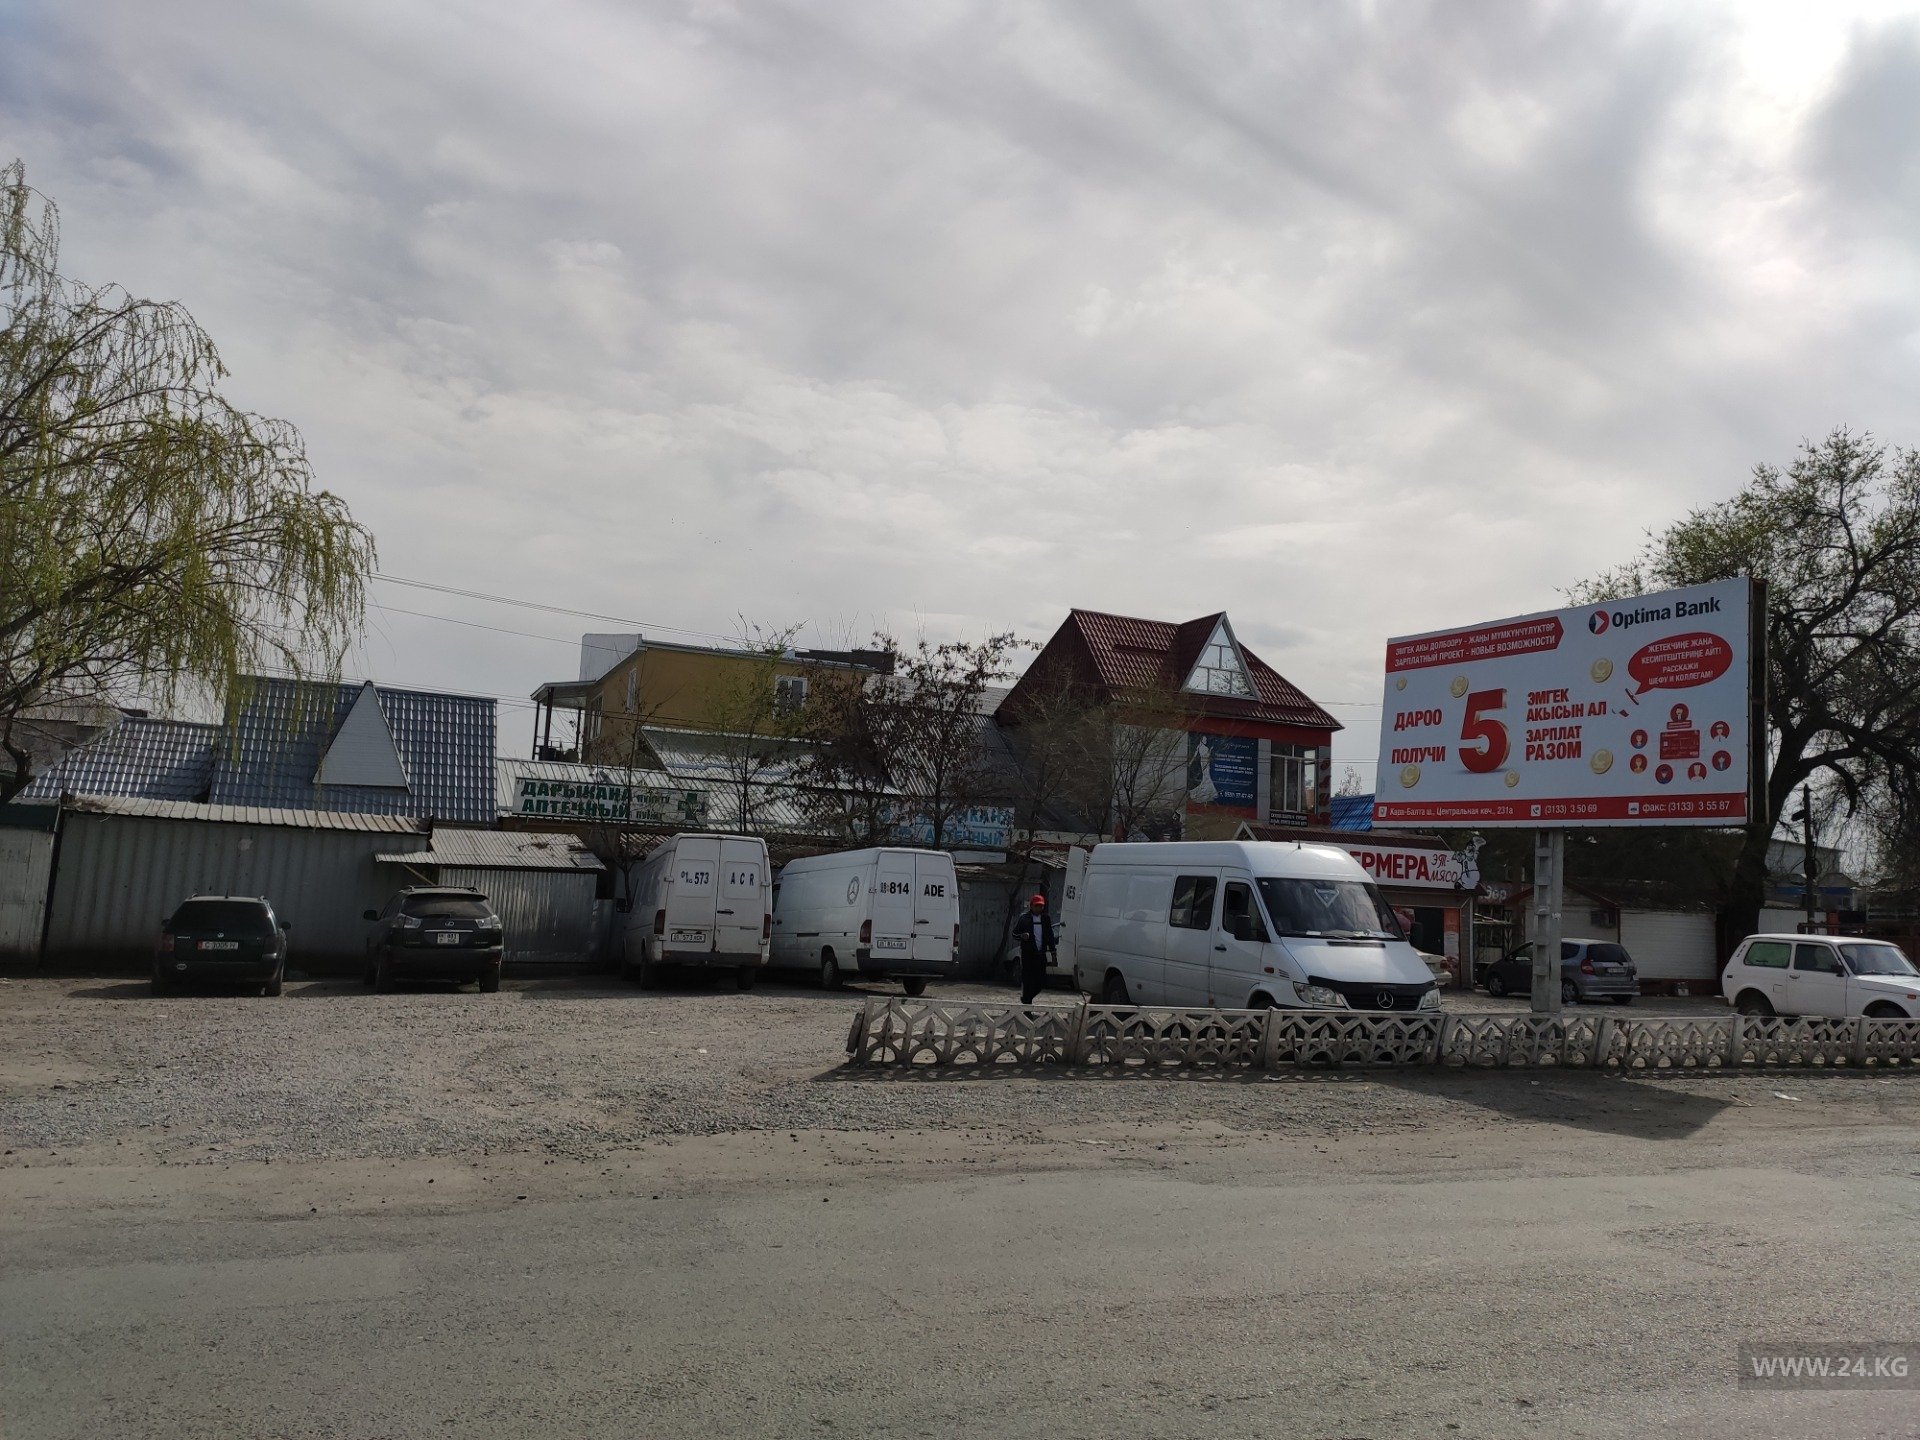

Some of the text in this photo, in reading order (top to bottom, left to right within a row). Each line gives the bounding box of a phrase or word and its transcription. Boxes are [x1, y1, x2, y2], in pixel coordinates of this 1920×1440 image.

[1612, 597, 1721, 629] Optima Bank
[1690, 637, 1713, 648] ЖАНА
[1394, 652, 1438, 667] ЗАРПЛАТНЫЙ
[1438, 650, 1465, 661] ПРОЕКТ
[1471, 645, 1496, 656] НОВЫЕ
[1497, 636, 1556, 653] ВОЗМОЖНОСТИ
[1662, 662, 1699, 674] РАССКАЖИ
[1648, 676, 1668, 685] ШЕФУ
[1527, 688, 1570, 706] ЭМГЕК
[1394, 708, 1443, 731] ДАРОО
[1526, 701, 1607, 722] АКЫСЫН АЛ
[1458, 687, 1511, 774] 5
[1526, 726, 1583, 743] ЗАРПЛАТ
[1391, 745, 1446, 764] ПОЛУЧИ
[1525, 741, 1582, 761] РАЗОМ
[522, 799, 630, 818] АПТЕЧНЫЙ
[1436, 806, 1481, 817] Центральная
[1544, 804, 1567, 814] (3133)
[1576, 804, 1586, 813] 50
[1588, 804, 1598, 812] 69
[1668, 801, 1694, 814] (3133)
[1706, 801, 1717, 811] 55
[1719, 800, 1730, 810] 87
[694, 872, 710, 885] 573
[890, 882, 910, 895] 814
[924, 884, 944, 898] ADE
